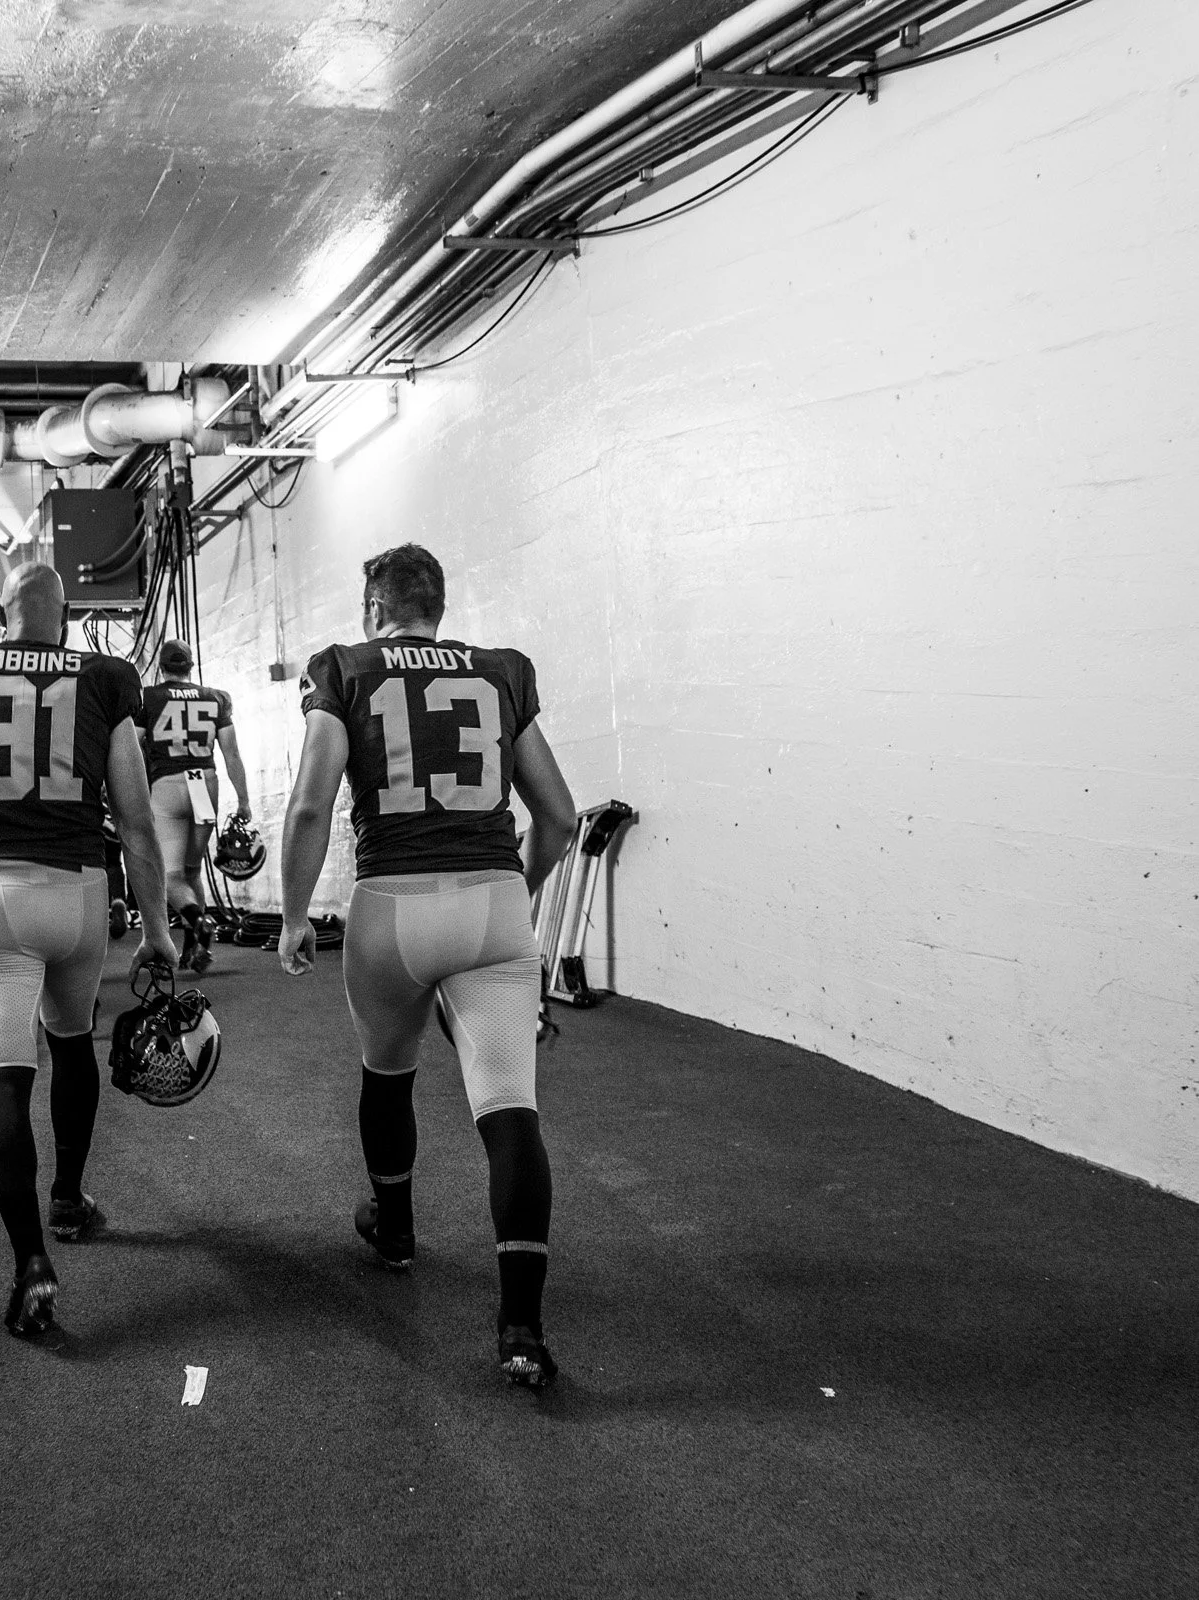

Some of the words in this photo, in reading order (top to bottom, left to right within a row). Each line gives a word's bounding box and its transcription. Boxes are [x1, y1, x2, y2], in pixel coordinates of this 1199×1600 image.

[380, 646, 475, 670] MOODY
[168, 688, 200, 699] TARR
[152, 700, 219, 758] 45
[369, 677, 503, 815] 13
[187, 770, 203, 780] M
